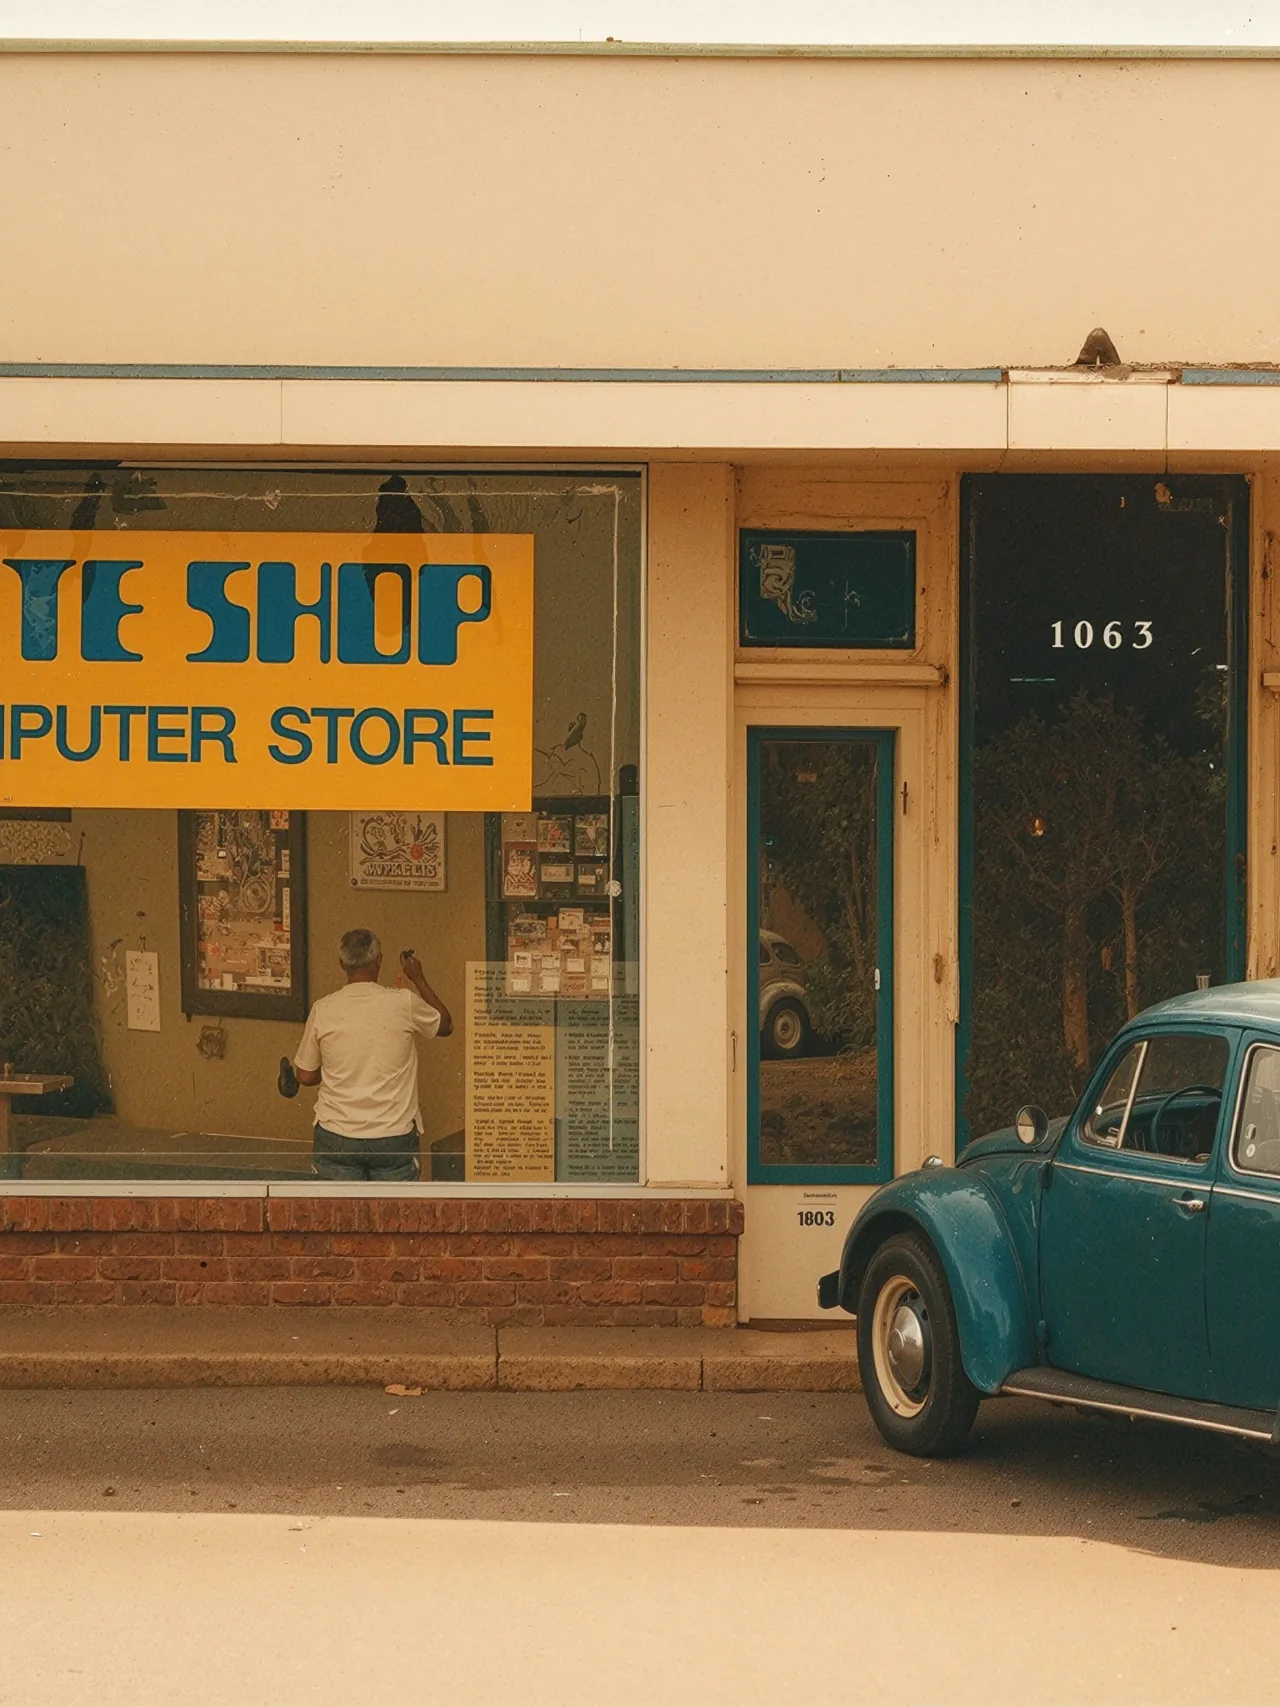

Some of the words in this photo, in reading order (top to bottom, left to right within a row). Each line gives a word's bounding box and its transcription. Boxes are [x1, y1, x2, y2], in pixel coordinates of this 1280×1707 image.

[186, 562, 491, 665] SHOP
[1050, 621, 1154, 650] 1063
[0, 705, 236, 762] PUTER
[269, 707, 493, 765] STORE
[796, 1210, 835, 1227] 1803
